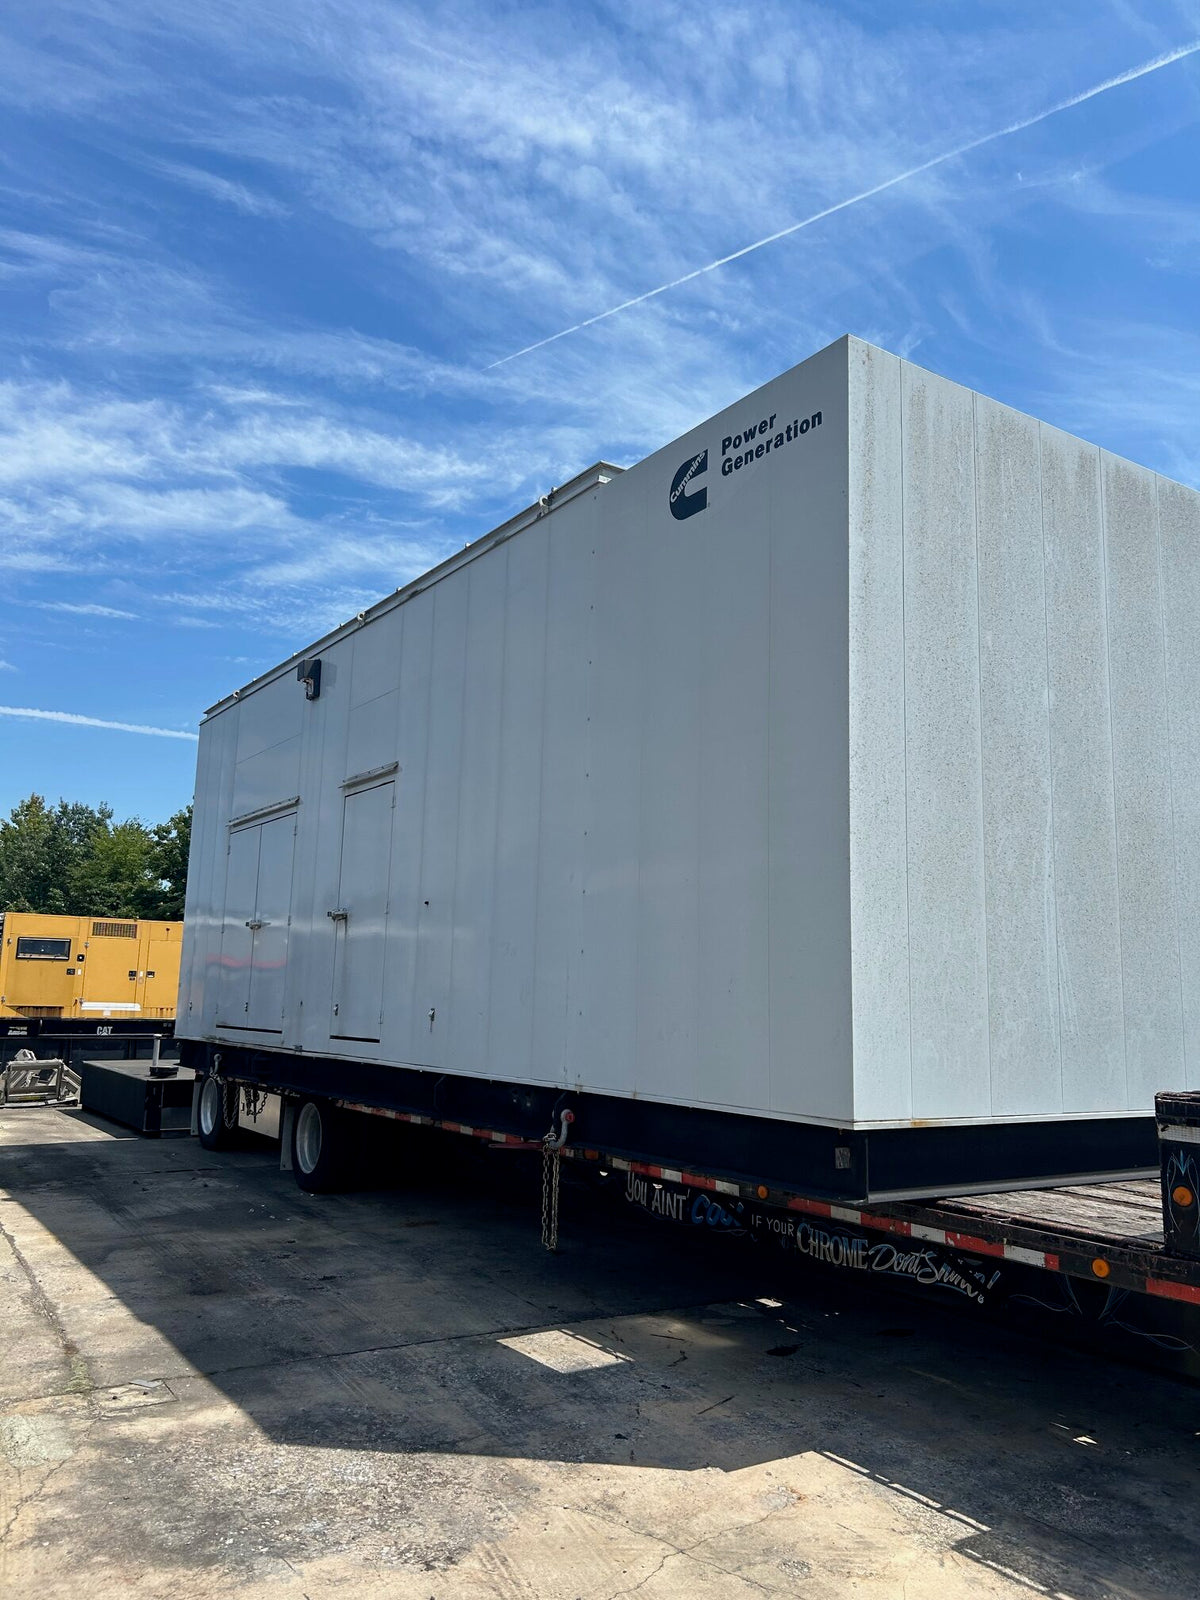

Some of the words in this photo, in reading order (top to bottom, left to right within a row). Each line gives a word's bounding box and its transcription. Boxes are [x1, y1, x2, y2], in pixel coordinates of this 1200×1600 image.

[721, 413, 777, 456] Power
[721, 411, 823, 476] Generation
[670, 452, 706, 503] Cummins
[96, 1026, 113, 1036] CAT
[751, 1213, 763, 1228] IF
[766, 1217, 795, 1237] YOUR
[796, 1222, 869, 1269] CHROME
